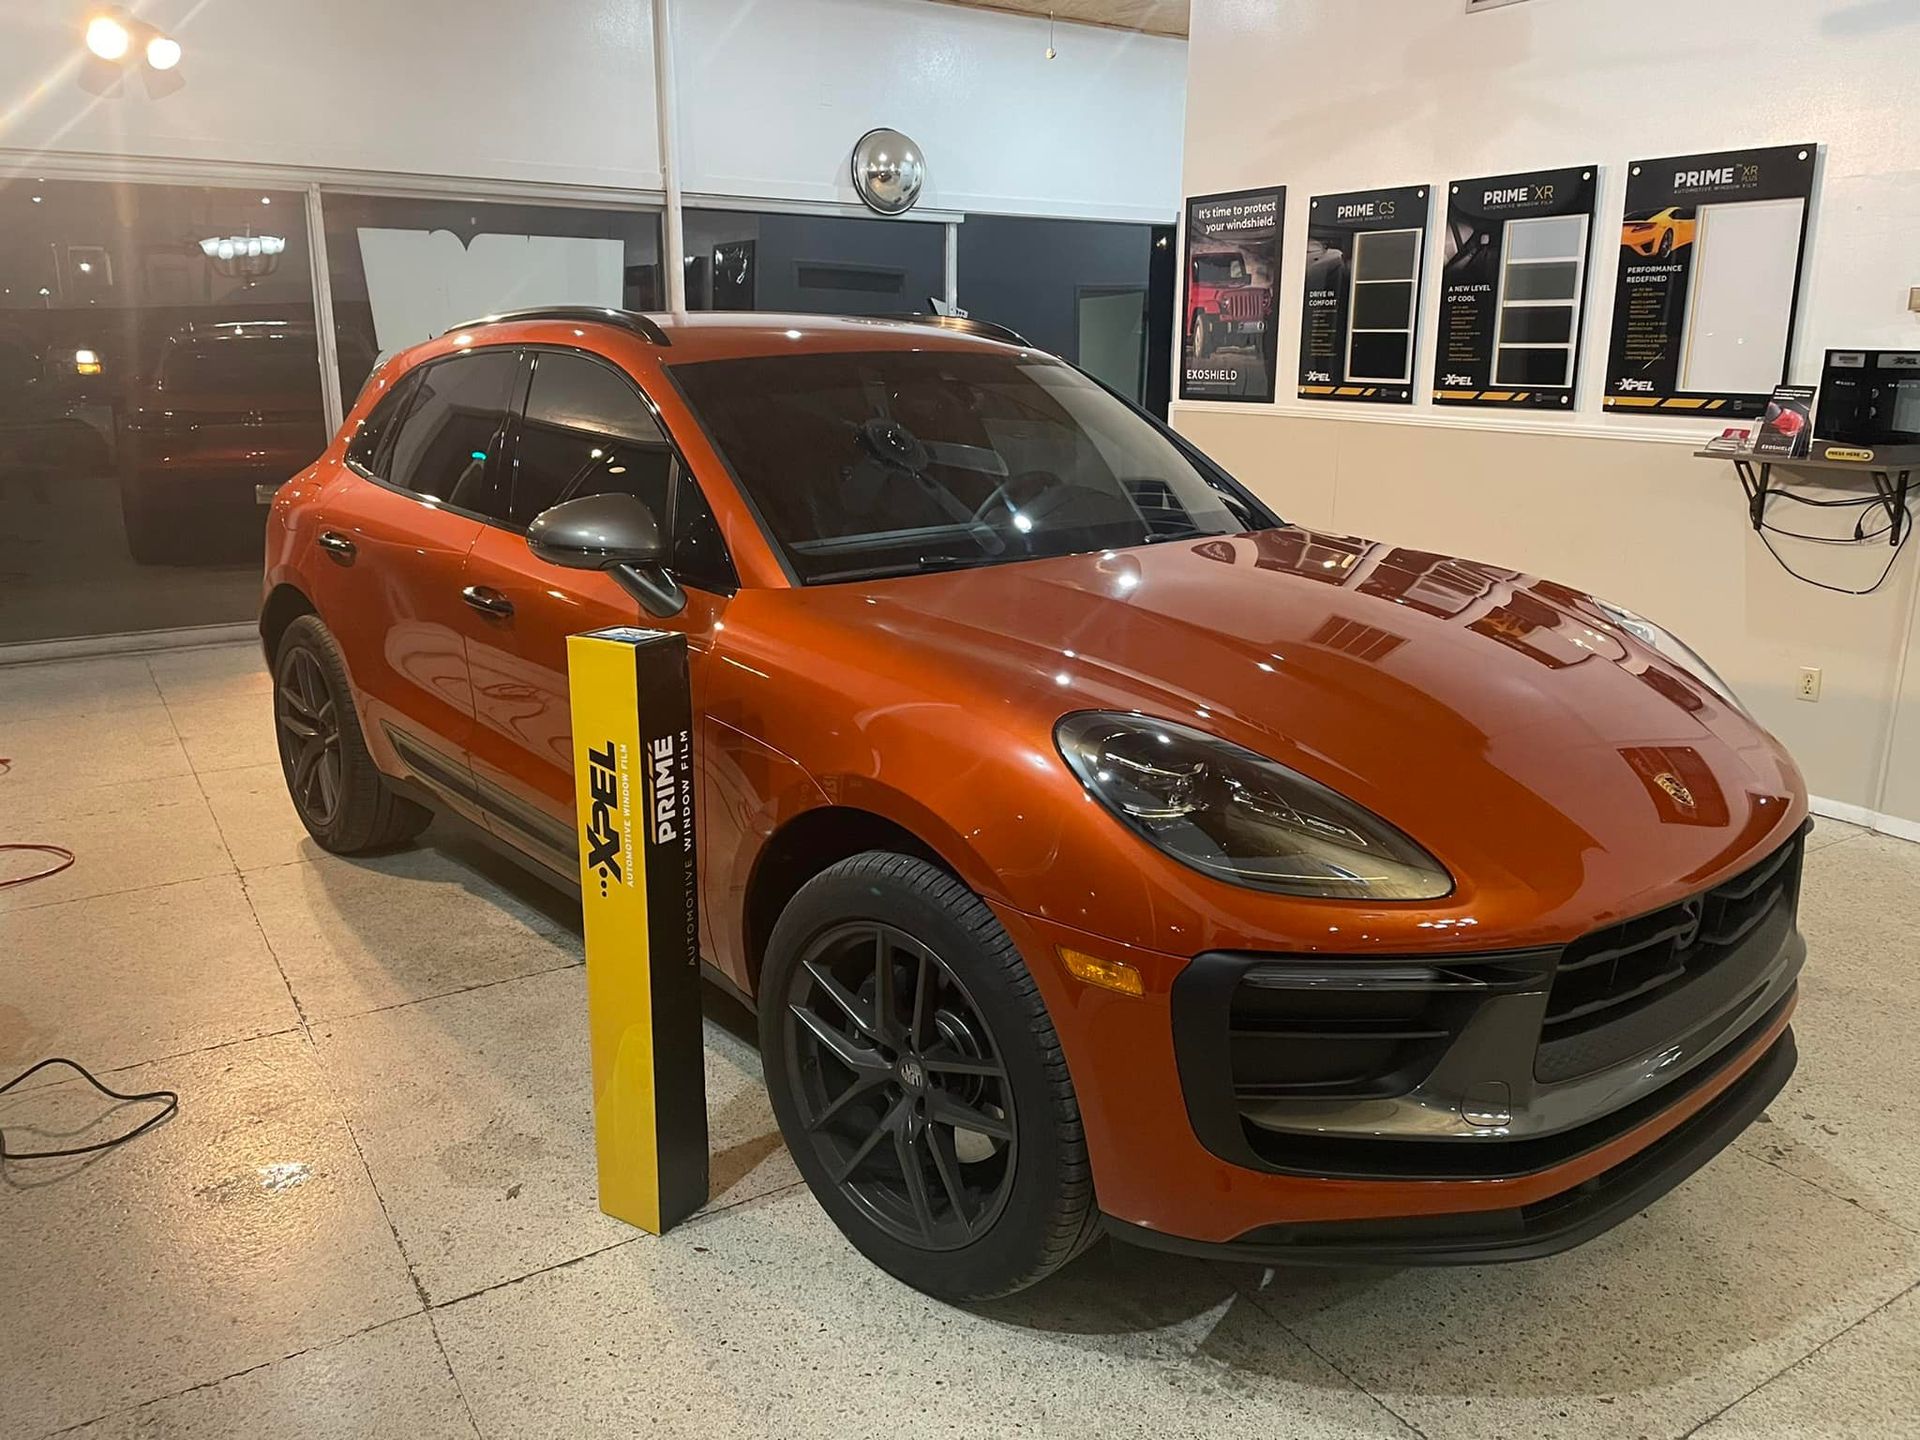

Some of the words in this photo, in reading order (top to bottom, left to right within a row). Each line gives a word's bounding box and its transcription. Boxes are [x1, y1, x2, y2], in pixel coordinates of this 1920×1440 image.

[1674, 167, 1734, 188] PRIME
[1743, 165, 1758, 176] XR
[1483, 187, 1528, 204] PRIME
[1534, 185, 1554, 200] XR
[1198, 208, 1211, 219] It's
[1212, 206, 1231, 218] time
[1233, 206, 1242, 215] to
[1244, 202, 1276, 216] protect
[1337, 203, 1374, 218] PRIME
[1379, 201, 1395, 214] CS
[1205, 223, 1225, 234] your
[1226, 216, 1275, 230] windshield.
[1627, 264, 1683, 274] PERFORMANCE
[1186, 369, 1237, 380] EXOSHIELD
[1306, 370, 1330, 381] XPEL
[1444, 374, 1472, 386] XPEL
[1618, 378, 1654, 391] XPEL
[680, 730, 689, 771] FILM
[623, 774, 631, 818] WINDOW
[654, 735, 677, 846] PRIME
[586, 740, 622, 885] XPEL
[682, 779, 692, 852] WINDOW
[624, 821, 634, 888] AUTOMOTIVE
[685, 858, 696, 966] AUTOMOTIVE
